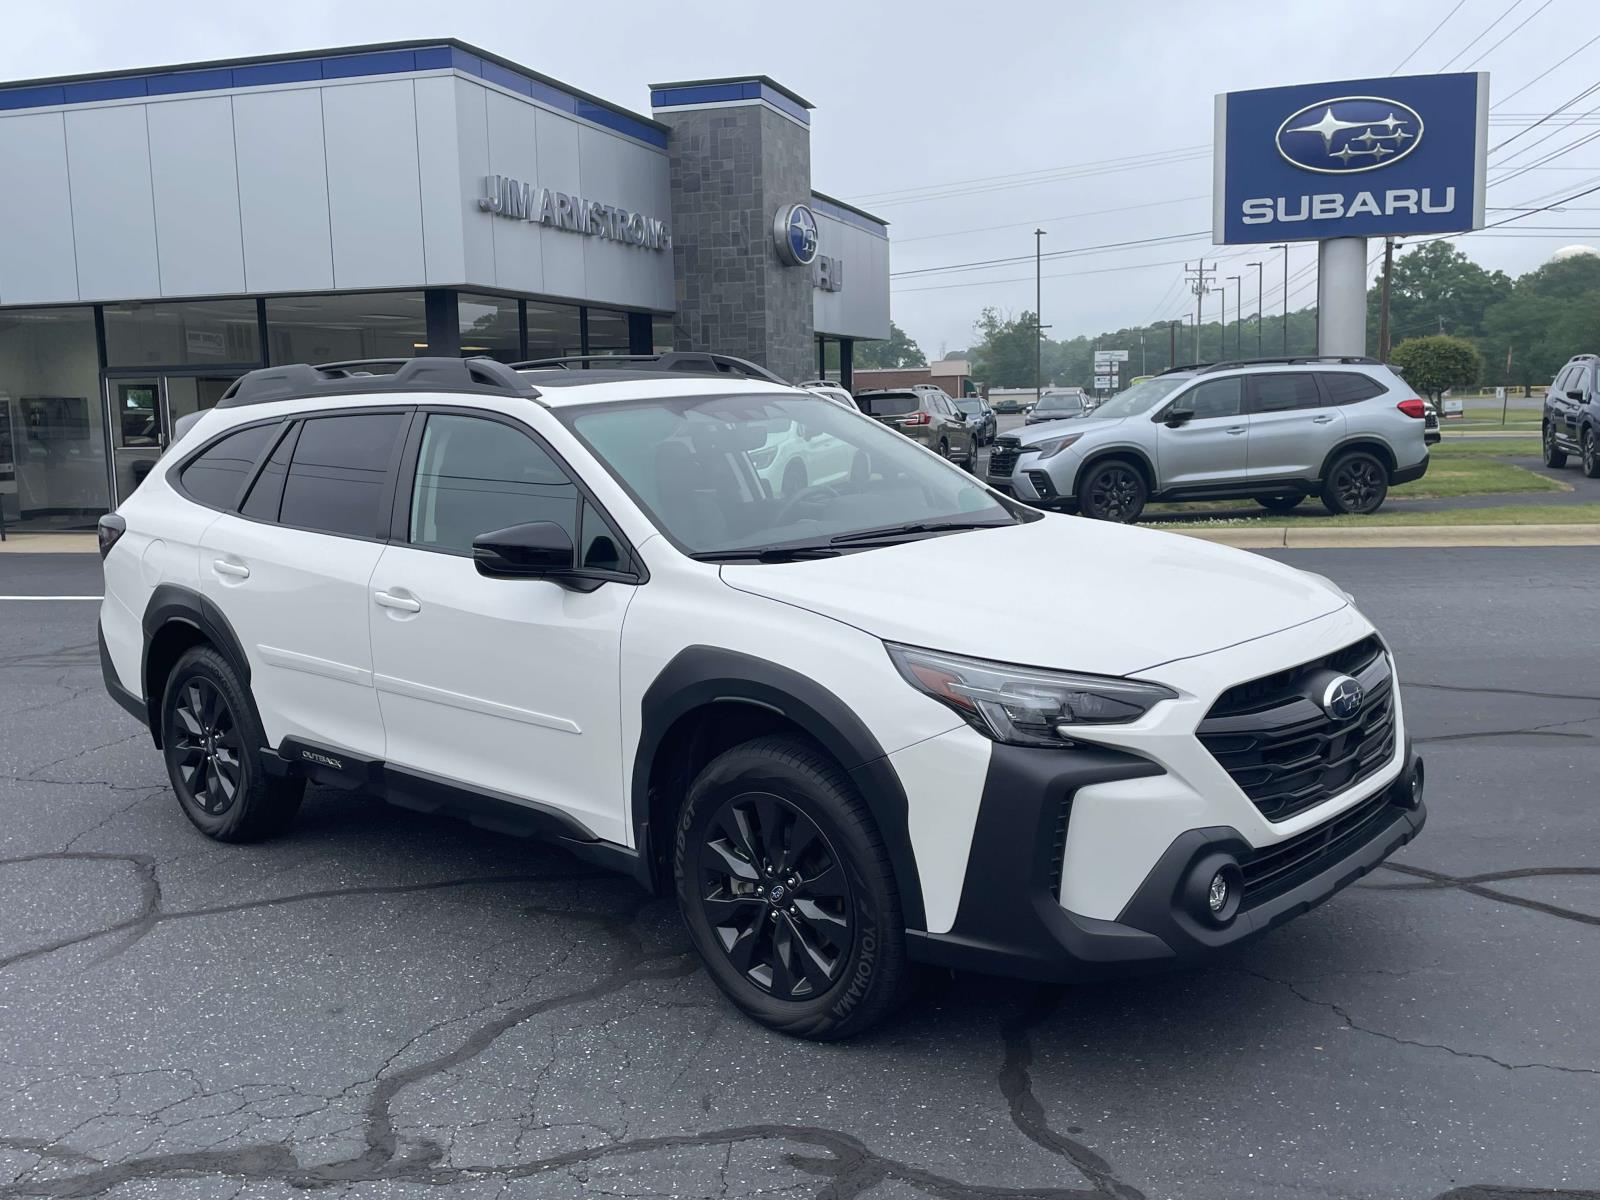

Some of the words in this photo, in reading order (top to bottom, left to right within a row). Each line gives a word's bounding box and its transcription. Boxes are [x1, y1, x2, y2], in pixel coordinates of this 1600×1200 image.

[480, 175, 530, 219] JIM
[533, 187, 671, 249] ARMSTRONG
[1242, 187, 1455, 224] SUBARU
[302, 750, 342, 769] OUTBACK
[832, 926, 876, 1018] YOKOHAMA
